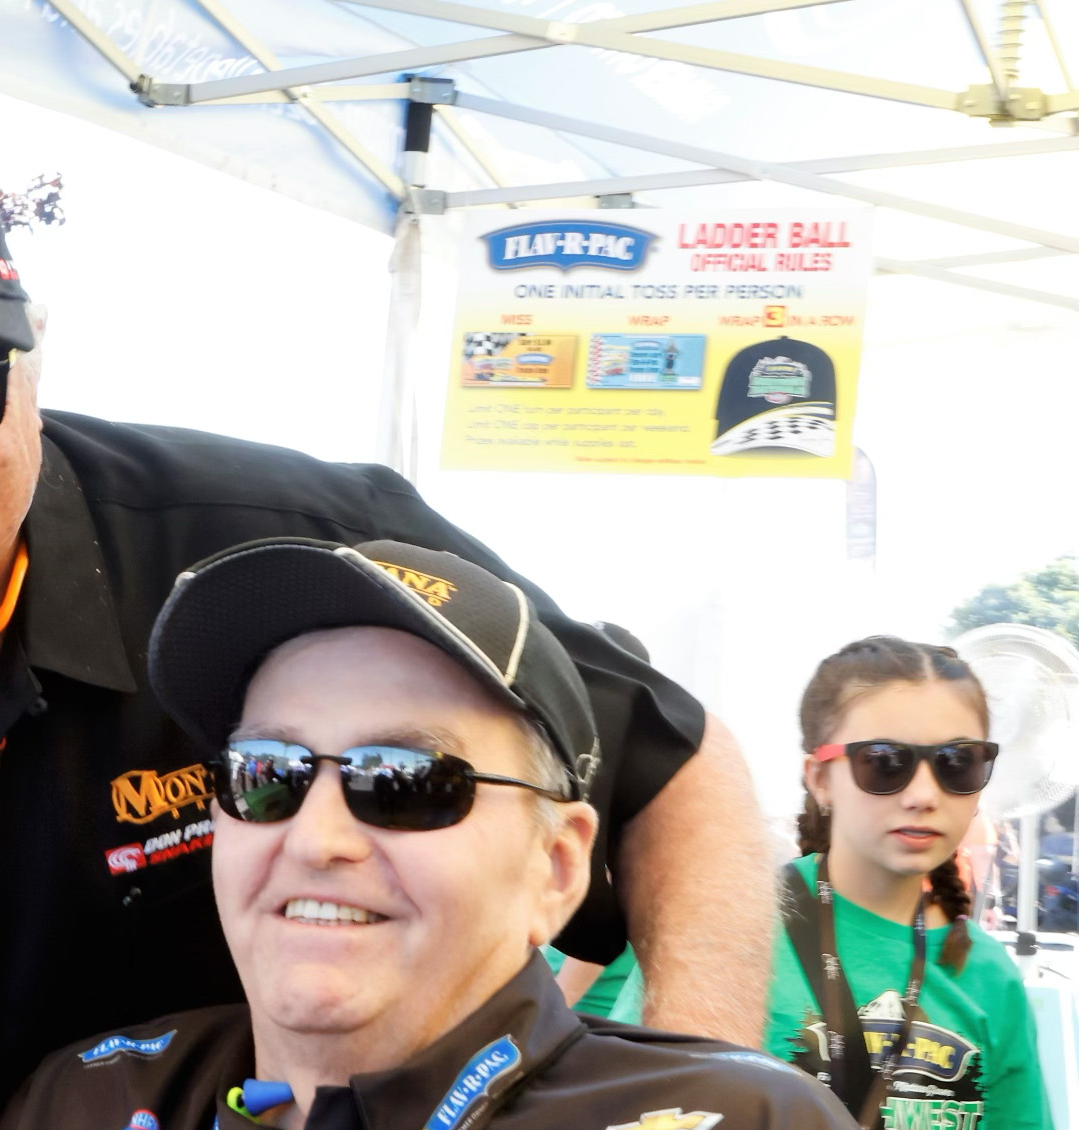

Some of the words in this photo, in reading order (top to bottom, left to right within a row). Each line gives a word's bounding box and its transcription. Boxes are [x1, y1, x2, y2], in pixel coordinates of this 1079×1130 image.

[678, 222, 778, 248] LADDER
[787, 221, 851, 248] BALL
[690, 252, 768, 272] OFFICIAL
[774, 252, 833, 272] RULES
[514, 284, 555, 299] ONE
[561, 284, 625, 299] INITIAL
[631, 284, 678, 299] TOSS
[685, 284, 719, 300] PER
[725, 284, 802, 300] PERSON
[501, 314, 533, 325] MISS
[628, 315, 670, 326] WRAP
[719, 315, 760, 327] WRAP
[767, 309, 780, 322] 3
[822, 316, 856, 327] ROW
